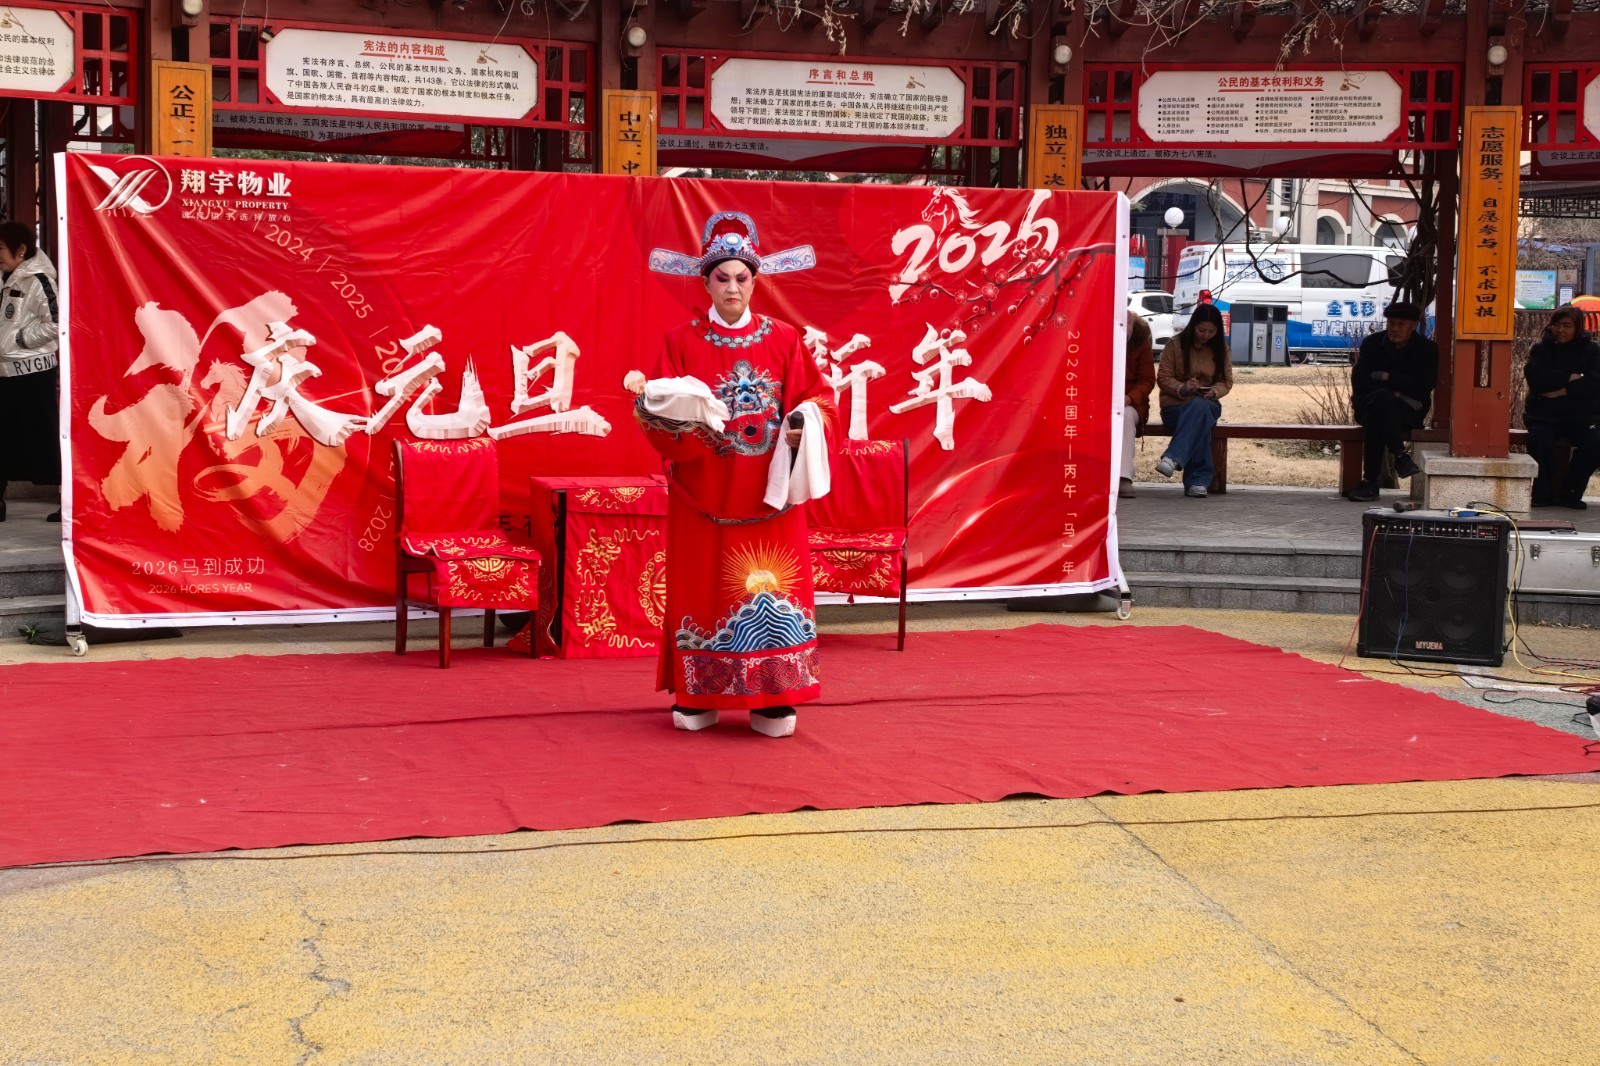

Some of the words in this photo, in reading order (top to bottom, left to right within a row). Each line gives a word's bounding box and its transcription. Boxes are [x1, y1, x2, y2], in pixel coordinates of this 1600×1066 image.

[363, 40, 445, 57] 宪法的内容构成
[809, 68, 873, 81] 序言和总纲
[1217, 76, 1325, 89] 公民的基本权利和义务
[169, 85, 196, 158] 公正：一
[657, 139, 769, 152] 会议上通过，被称为七五宪法。
[180, 168, 293, 198] 翔宇物业
[182, 198, 230, 208] XIANGYU
[235, 200, 289, 211] PROPERTY
[264, 224, 315, 262] 2024
[888, 189, 1060, 303] 2026
[330, 274, 374, 319] 2025
[358, 505, 392, 552] 2028
[131, 556, 266, 578] 2026马到成功
[148, 584, 177, 594] 2026
[180, 583, 220, 594] HORES
[222, 582, 253, 593] YEAR
